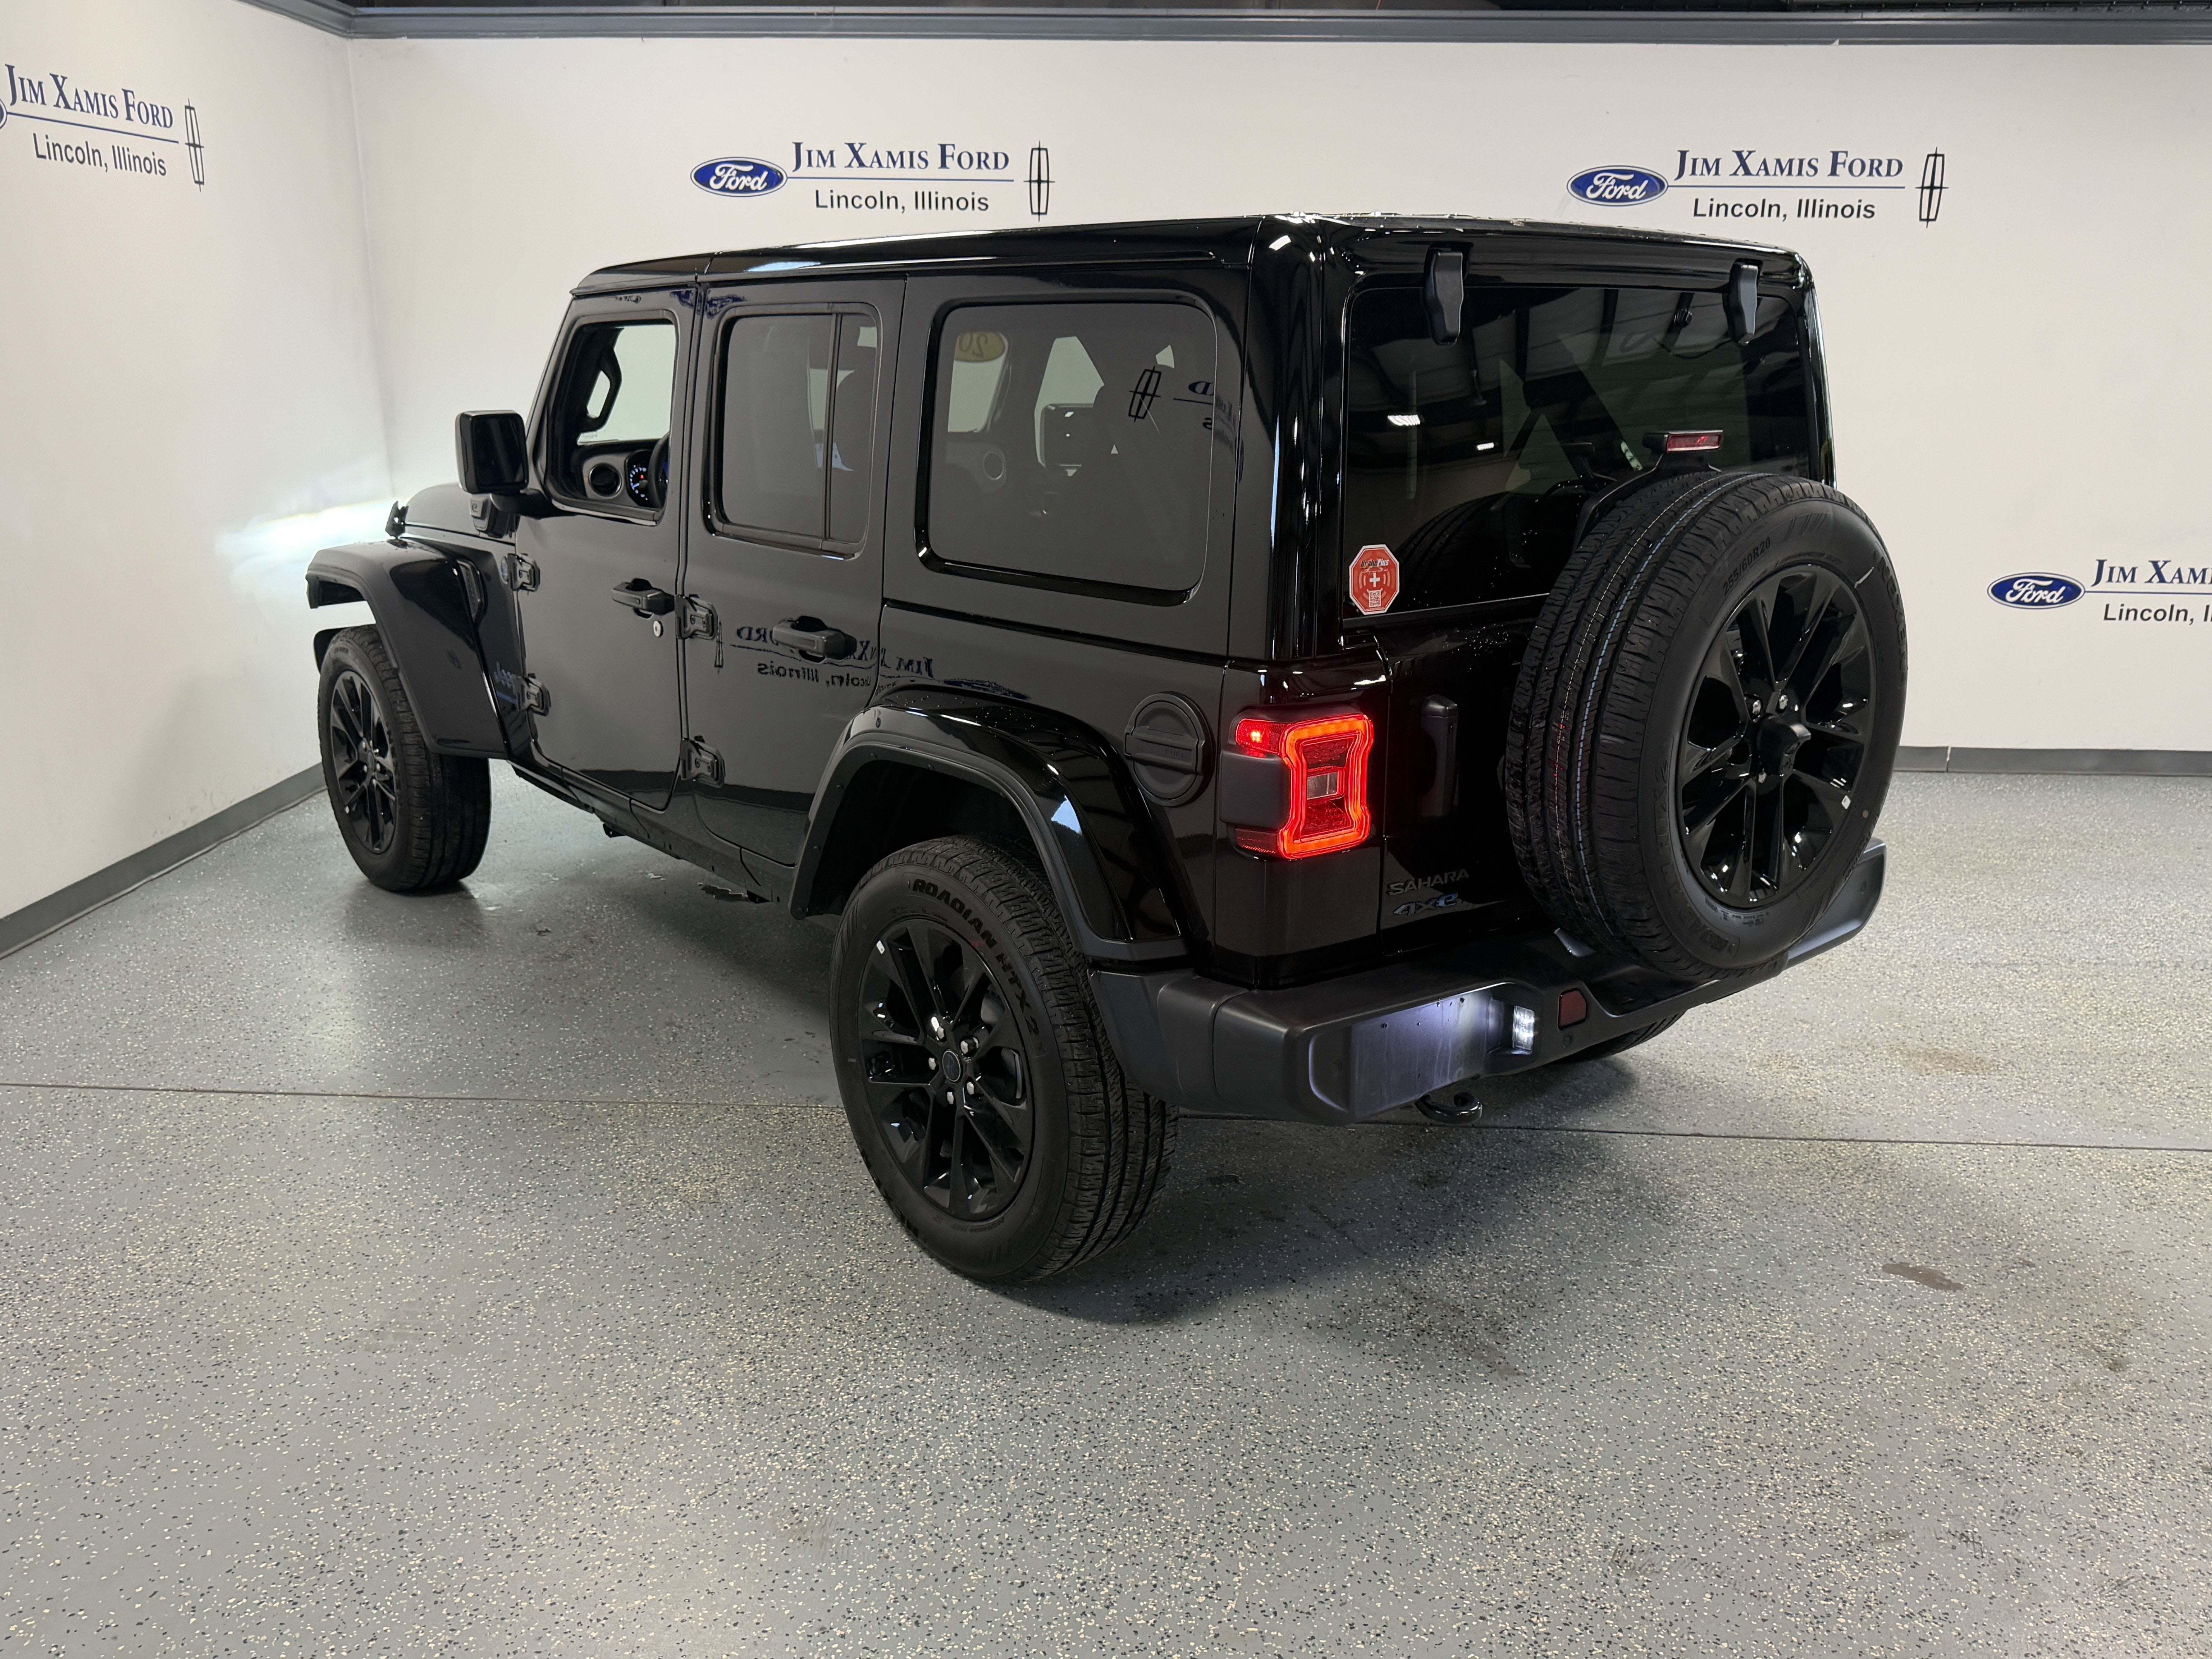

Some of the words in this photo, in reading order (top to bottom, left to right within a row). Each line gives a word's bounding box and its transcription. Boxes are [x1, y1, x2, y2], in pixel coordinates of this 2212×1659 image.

[5, 64, 46, 106] JIM
[49, 73, 118, 119] XAMIS
[122, 88, 173, 129] FORD
[33, 132, 108, 173] Lincoln,
[112, 145, 167, 176] Illinois
[792, 142, 836, 172] JIM
[844, 143, 929, 170] XAMIS
[938, 143, 1009, 170] FORD
[1674, 149, 1722, 181] JIM
[1729, 150, 1819, 177] XAMIS
[1827, 150, 1903, 177] FORD
[709, 163, 768, 191] Ford
[1585, 172, 1649, 200] Ford
[816, 189, 905, 214] Lincoln,
[915, 191, 989, 211] Illinois
[1693, 198, 1787, 222] Lincoln,
[1797, 198, 1875, 219] Illinois
[2090, 559, 2138, 587] JIM
[2005, 578, 2066, 603] Ford
[2103, 603, 2194, 625] Lincoln,
[1386, 868, 1469, 895] SAHARA
